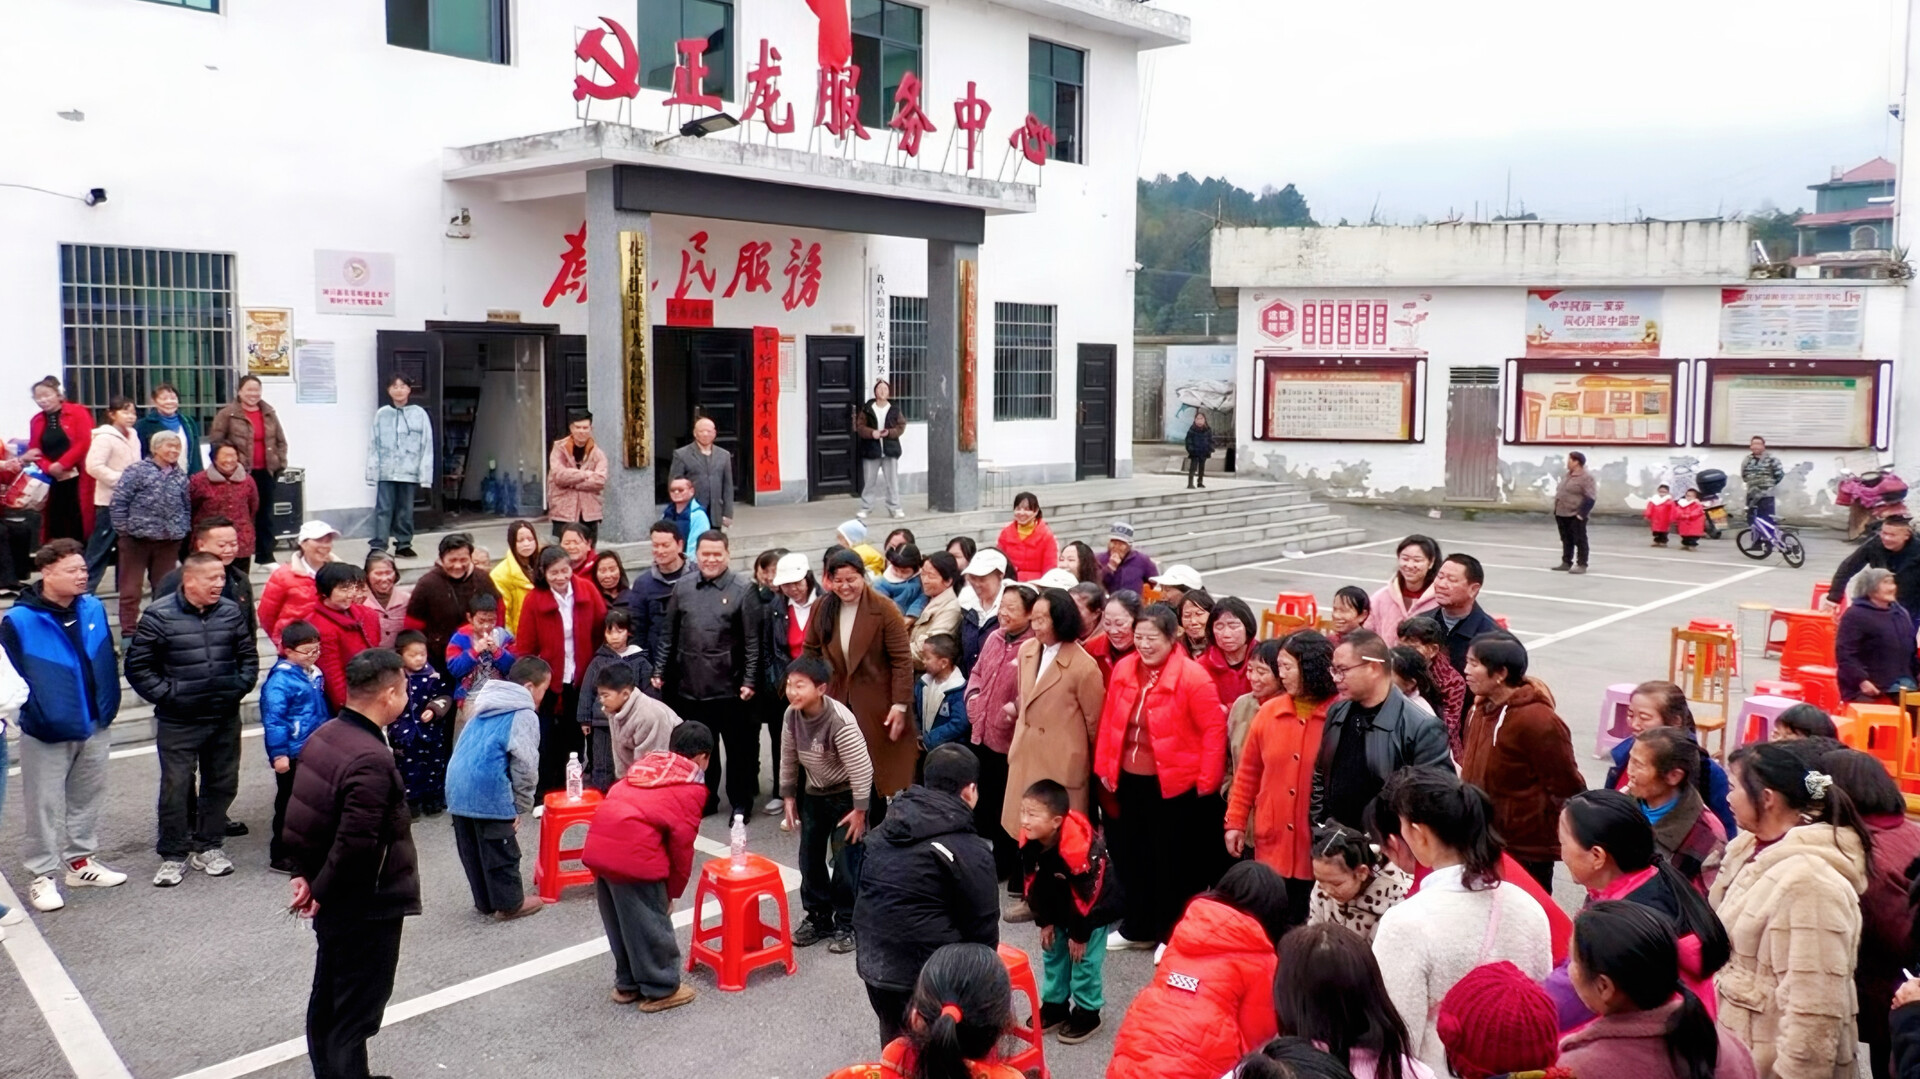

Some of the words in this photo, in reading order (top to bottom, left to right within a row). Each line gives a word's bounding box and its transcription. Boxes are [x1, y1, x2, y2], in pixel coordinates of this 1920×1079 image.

[662, 37, 1056, 171] 正龙服务中心
[543, 220, 823, 311] 為民服務
